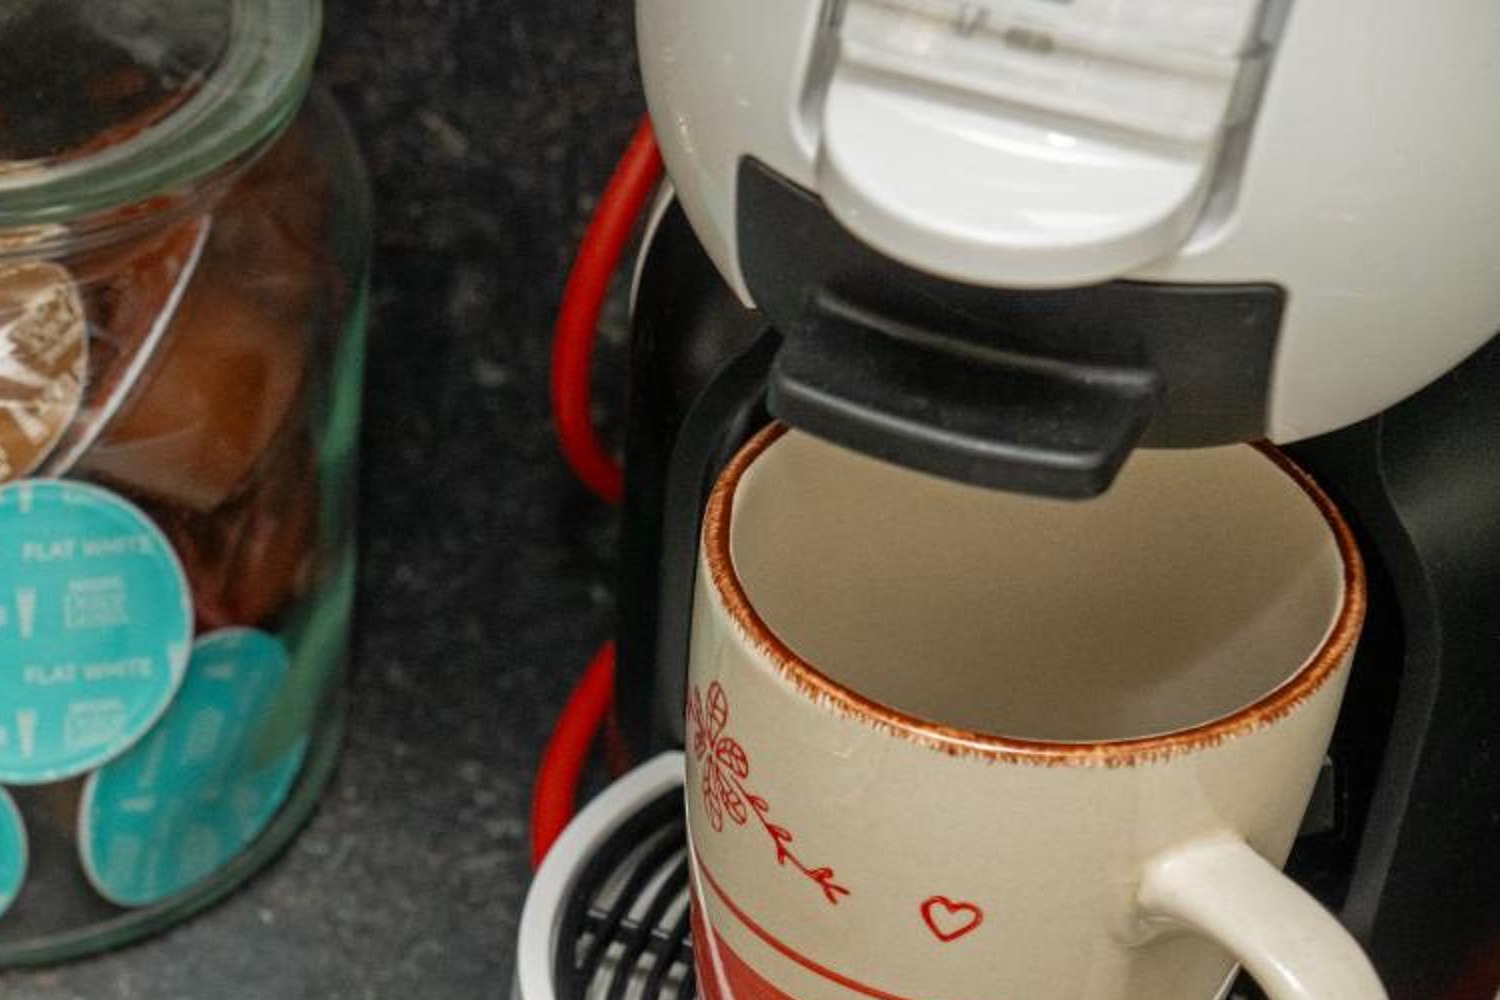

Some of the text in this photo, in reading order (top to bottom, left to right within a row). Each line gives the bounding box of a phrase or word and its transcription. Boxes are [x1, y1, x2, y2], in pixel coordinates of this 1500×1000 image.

[21, 534, 153, 562] FLAT WHITE
[23, 657, 153, 685] FLAT WHITE
